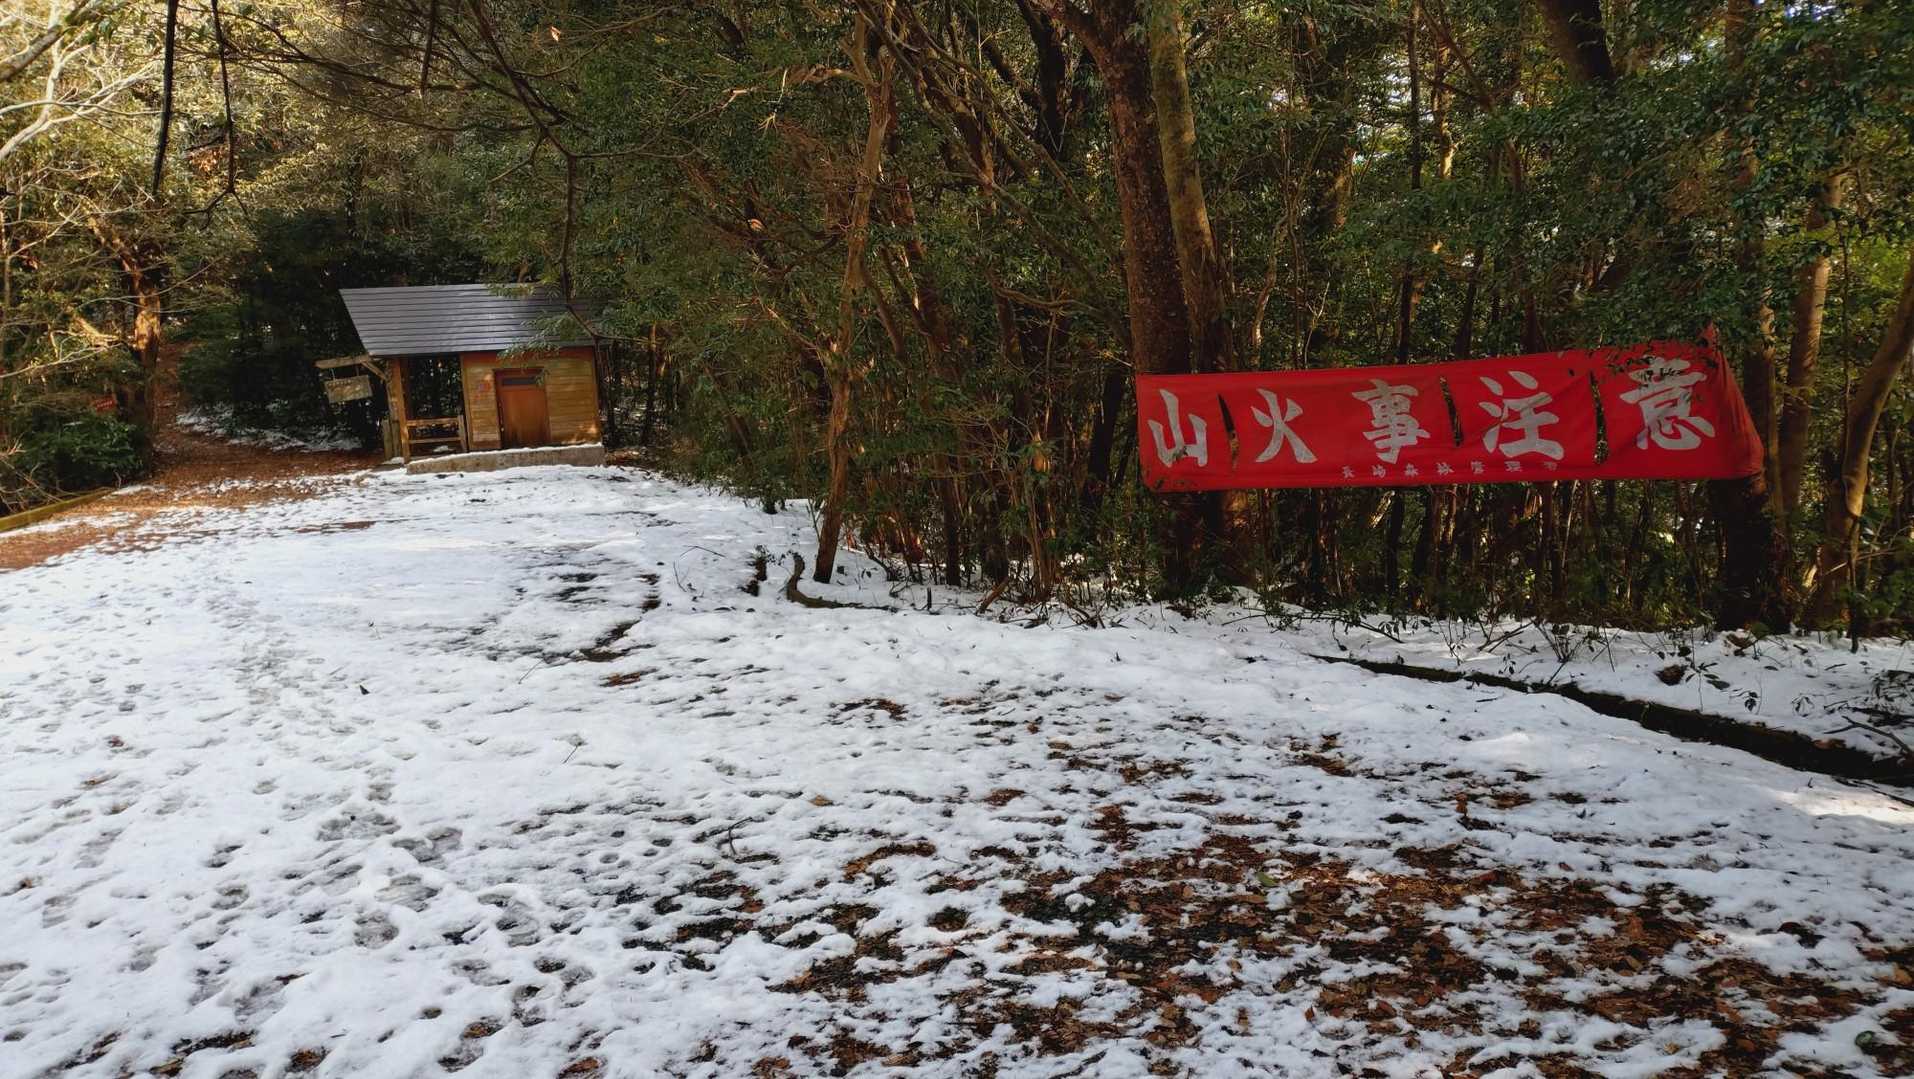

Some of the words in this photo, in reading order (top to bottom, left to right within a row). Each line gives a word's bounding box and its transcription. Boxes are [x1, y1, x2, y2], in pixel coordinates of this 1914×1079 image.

[1149, 357, 1715, 468] 山火事注意
